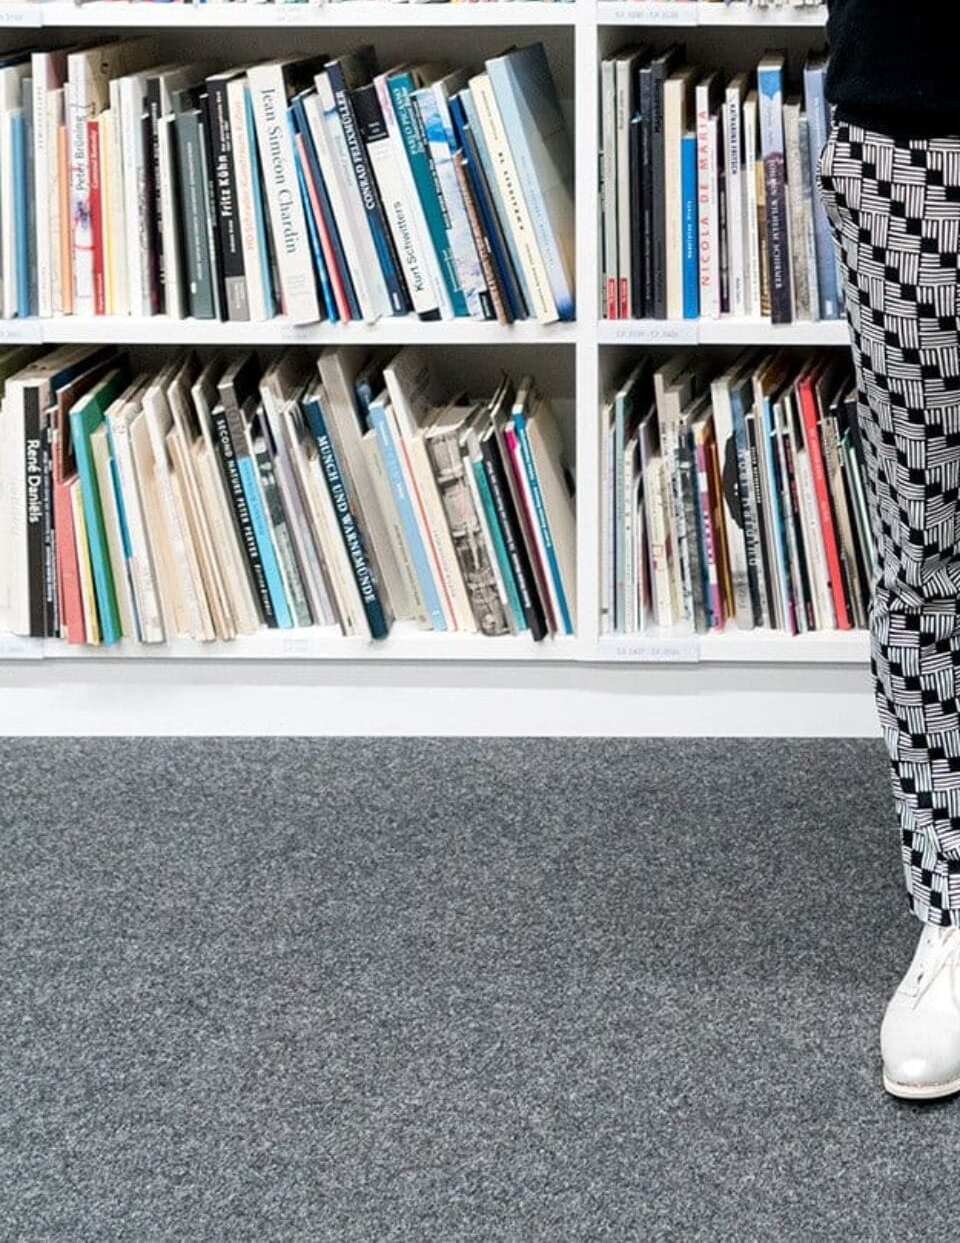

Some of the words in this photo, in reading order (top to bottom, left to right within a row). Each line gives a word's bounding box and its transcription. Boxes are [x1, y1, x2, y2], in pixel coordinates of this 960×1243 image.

[261, 89, 278, 121] Jean
[333, 88, 363, 163] FELIXMÜLLER
[392, 87, 410, 125] PICASSO
[75, 115, 86, 157] Brüning
[268, 125, 286, 187] Siméon
[699, 111, 708, 170] MARIA
[75, 161, 85, 191] Peter
[216, 151, 229, 179] Kühn
[353, 163, 376, 210] CONRAD
[220, 181, 232, 217] Fritz
[700, 184, 709, 204] DE
[276, 188, 296, 254] Chardin
[390, 200, 417, 265] Schwitters
[771, 198, 780, 242] WILHELM
[701, 216, 710, 286] NICOLA
[773, 244, 783, 289] SCHIRMER
[407, 265, 425, 293] Kurt
[26, 439, 41, 481] René
[215, 418, 233, 458] SECOND
[225, 459, 242, 494] NATURE
[235, 496, 249, 523] PETER
[28, 482, 43, 524] Daniëls
[317, 435, 338, 478] MUNCH
[331, 481, 347, 511] UND
[342, 511, 375, 604] WARNEMÜNDE
